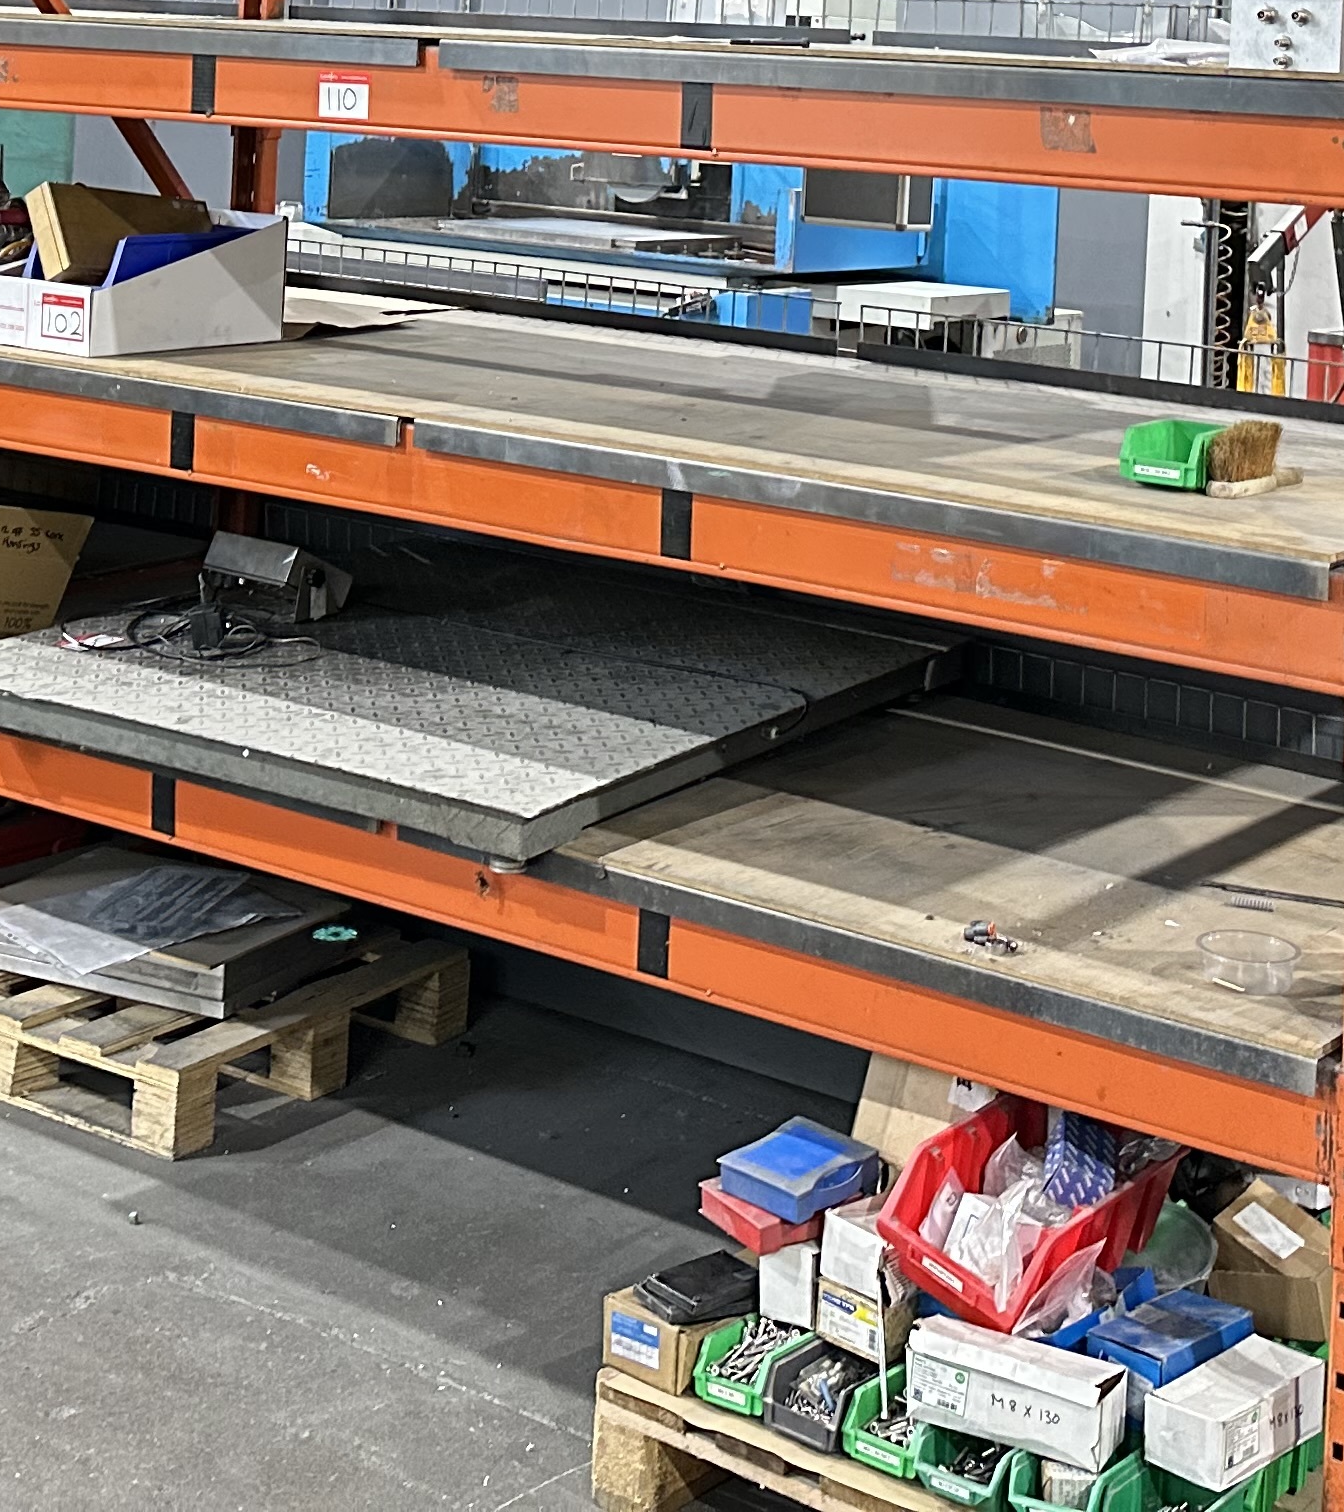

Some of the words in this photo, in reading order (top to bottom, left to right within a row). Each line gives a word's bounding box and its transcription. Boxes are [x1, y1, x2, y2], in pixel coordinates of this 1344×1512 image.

[328, 86, 357, 111] 110
[47, 307, 82, 336] 102
[4, 617, 33, 629] 100%
[1039, 1408, 1061, 1425] 130
